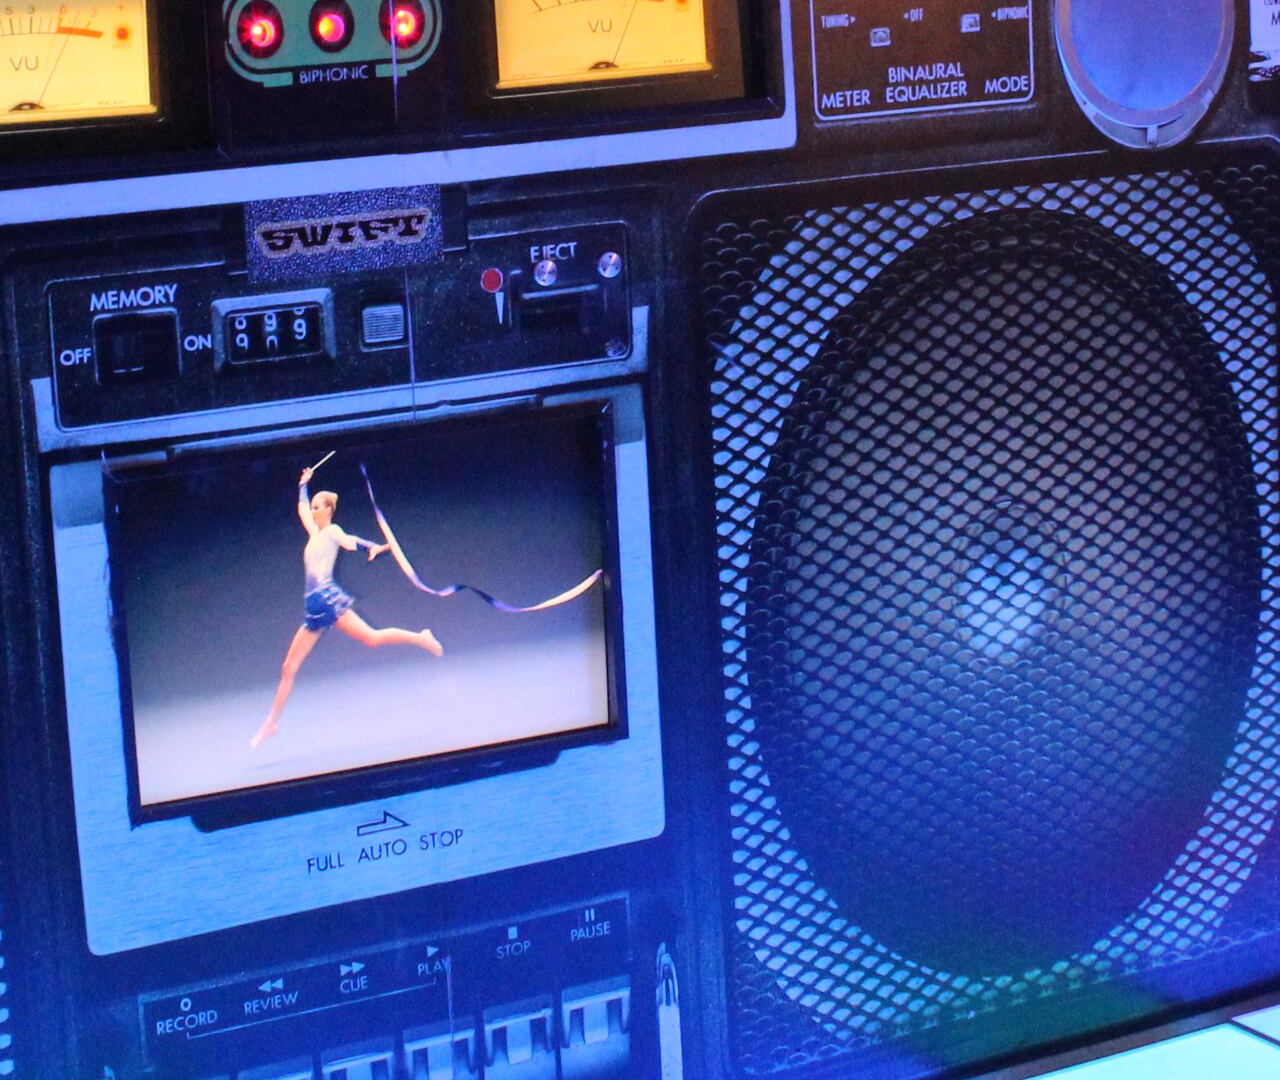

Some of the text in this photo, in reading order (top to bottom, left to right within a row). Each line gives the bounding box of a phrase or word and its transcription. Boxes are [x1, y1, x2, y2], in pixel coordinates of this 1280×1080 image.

[910, 8, 923, 22] OFF
[588, 19, 612, 33] VU
[10, 56, 39, 71] VU
[888, 62, 964, 83] BINAURAL
[300, 65, 368, 84] BIPHONIC
[886, 82, 967, 103] EQUALIZER
[985, 76, 1029, 94] MODE
[821, 89, 870, 109] METER
[260, 210, 427, 252] SWIFT
[530, 242, 577, 263] EJECT
[89, 284, 178, 312] MEMORY
[183, 334, 212, 352] ON
[60, 348, 92, 366] OFF
[307, 829, 464, 874] FULL AUTO STOP
[570, 921, 611, 942] PAUSE
[496, 940, 531, 960] STOP
[418, 956, 450, 976] PLAY
[340, 976, 368, 994] CUE
[244, 991, 299, 1016] REVIEW
[156, 1008, 218, 1035] RECORD
